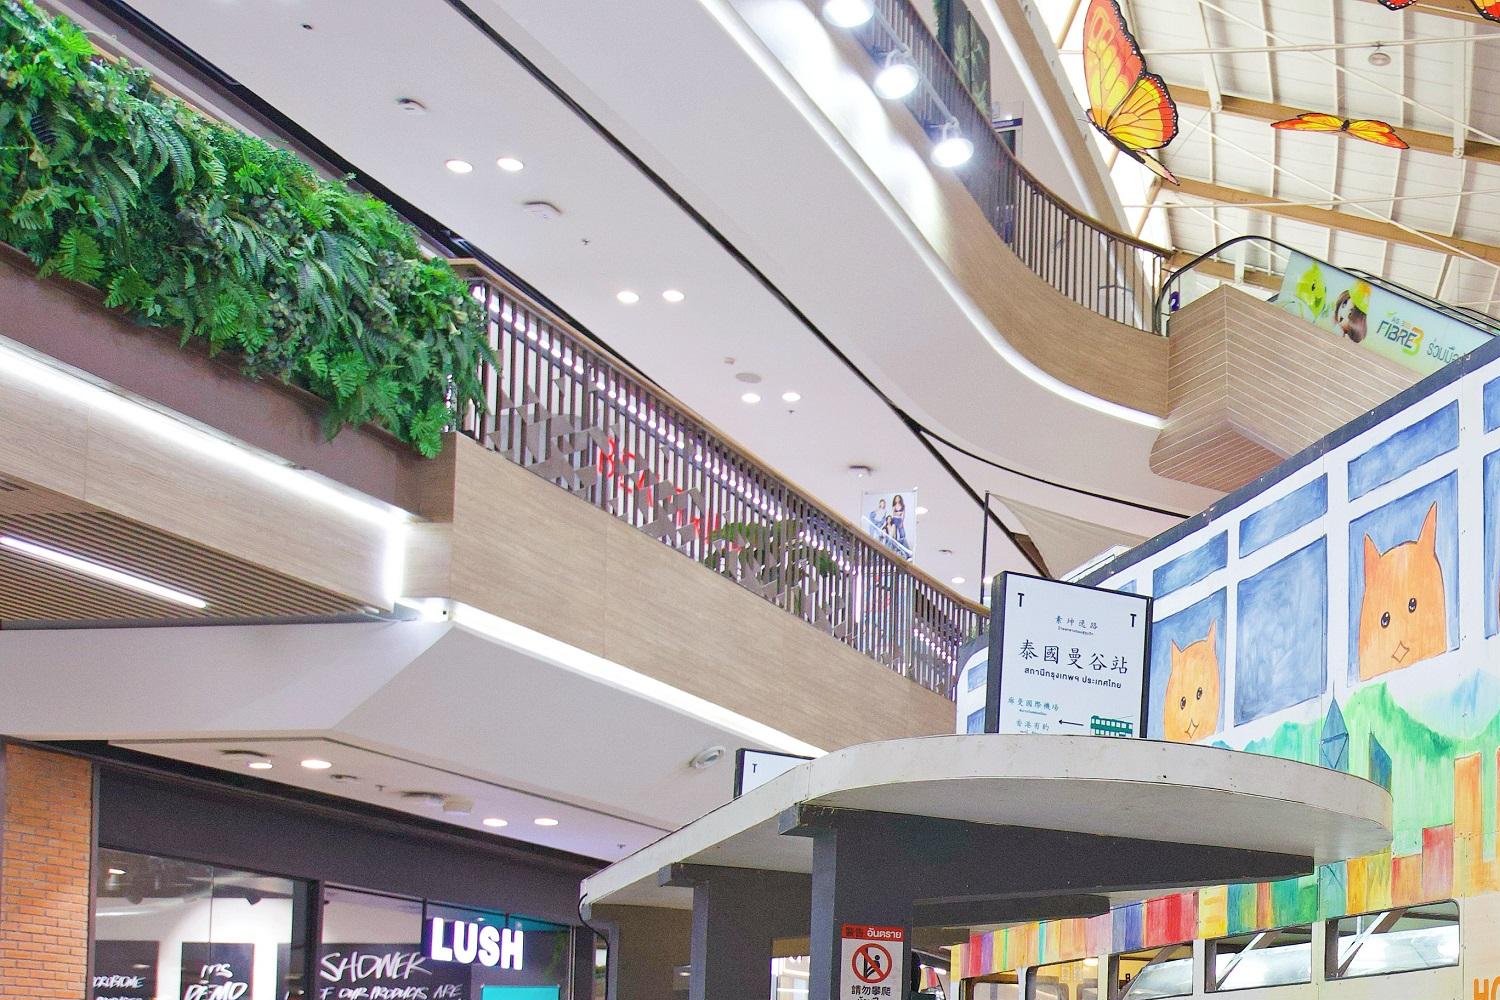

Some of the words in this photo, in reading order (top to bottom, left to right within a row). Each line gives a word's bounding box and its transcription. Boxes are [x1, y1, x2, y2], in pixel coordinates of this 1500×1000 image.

[1017, 592, 1024, 607] T
[1130, 613, 1137, 628] T
[1018, 639, 1128, 674] 泰國曼谷站
[431, 917, 524, 970] LUSH
[433, 983, 463, 999] ARE
[851, 984, 891, 997] 請勿攀爬
